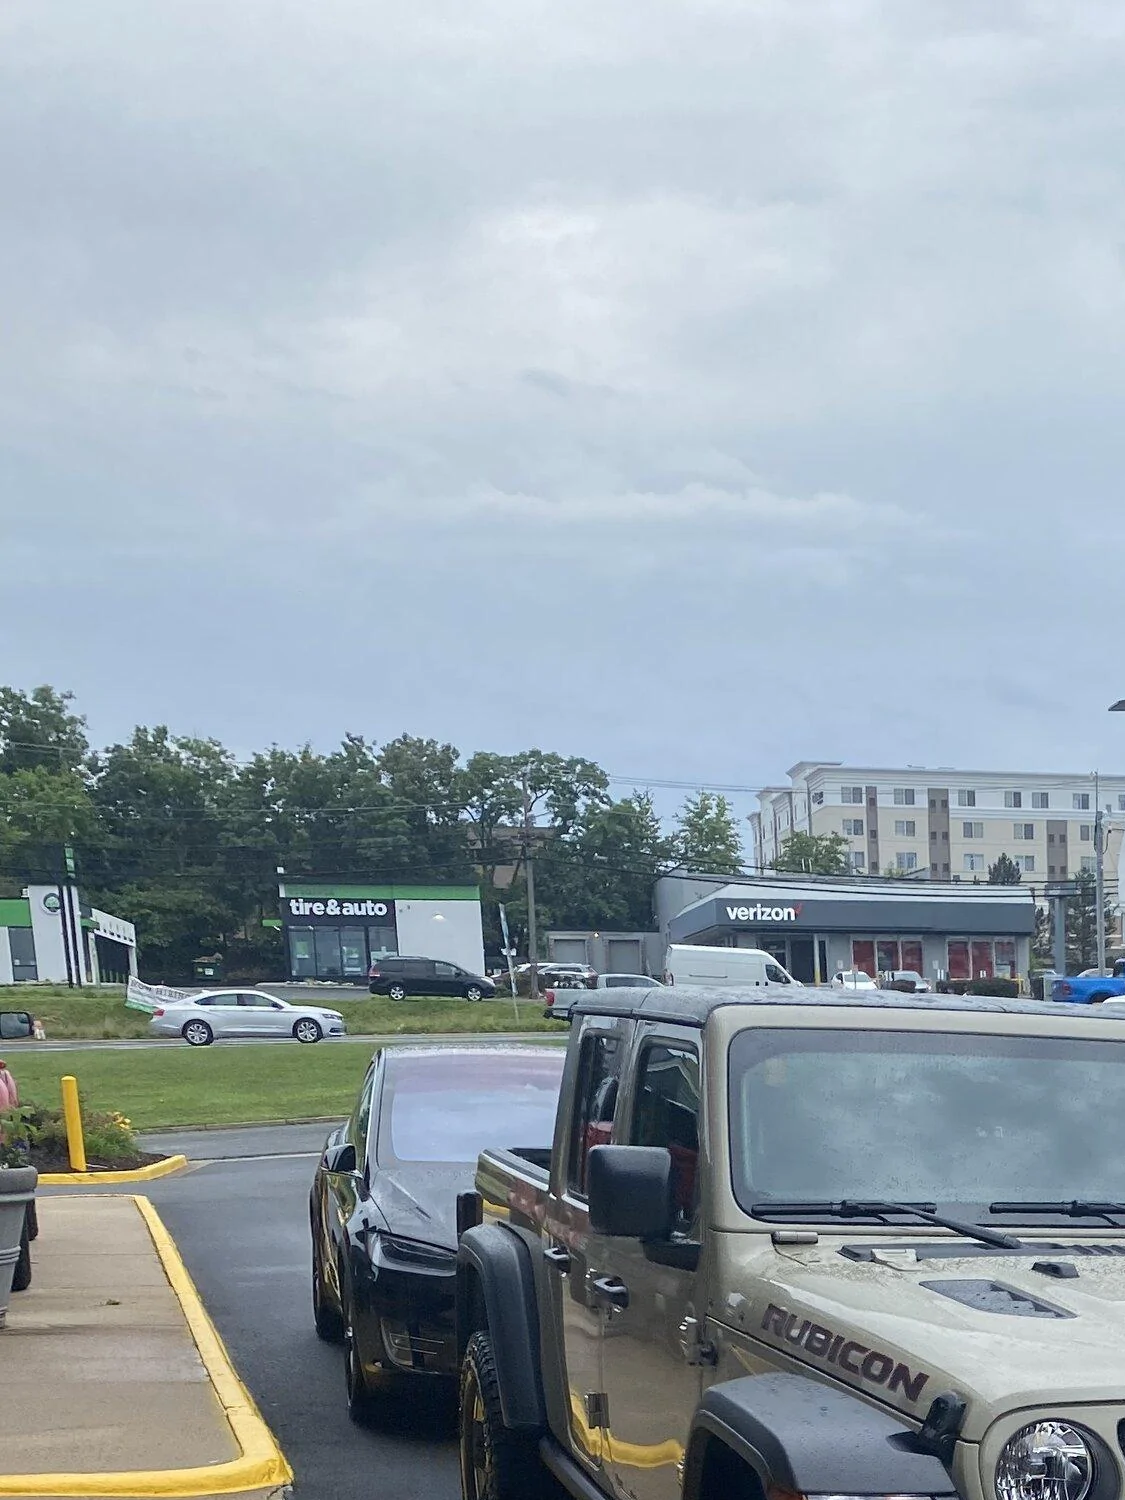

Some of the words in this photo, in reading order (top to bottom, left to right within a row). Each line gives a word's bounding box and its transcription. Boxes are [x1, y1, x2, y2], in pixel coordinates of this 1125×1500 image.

[290, 898, 388, 916] tire&auto
[726, 903, 796, 921] verizon
[760, 1303, 930, 1402] RUBICON
